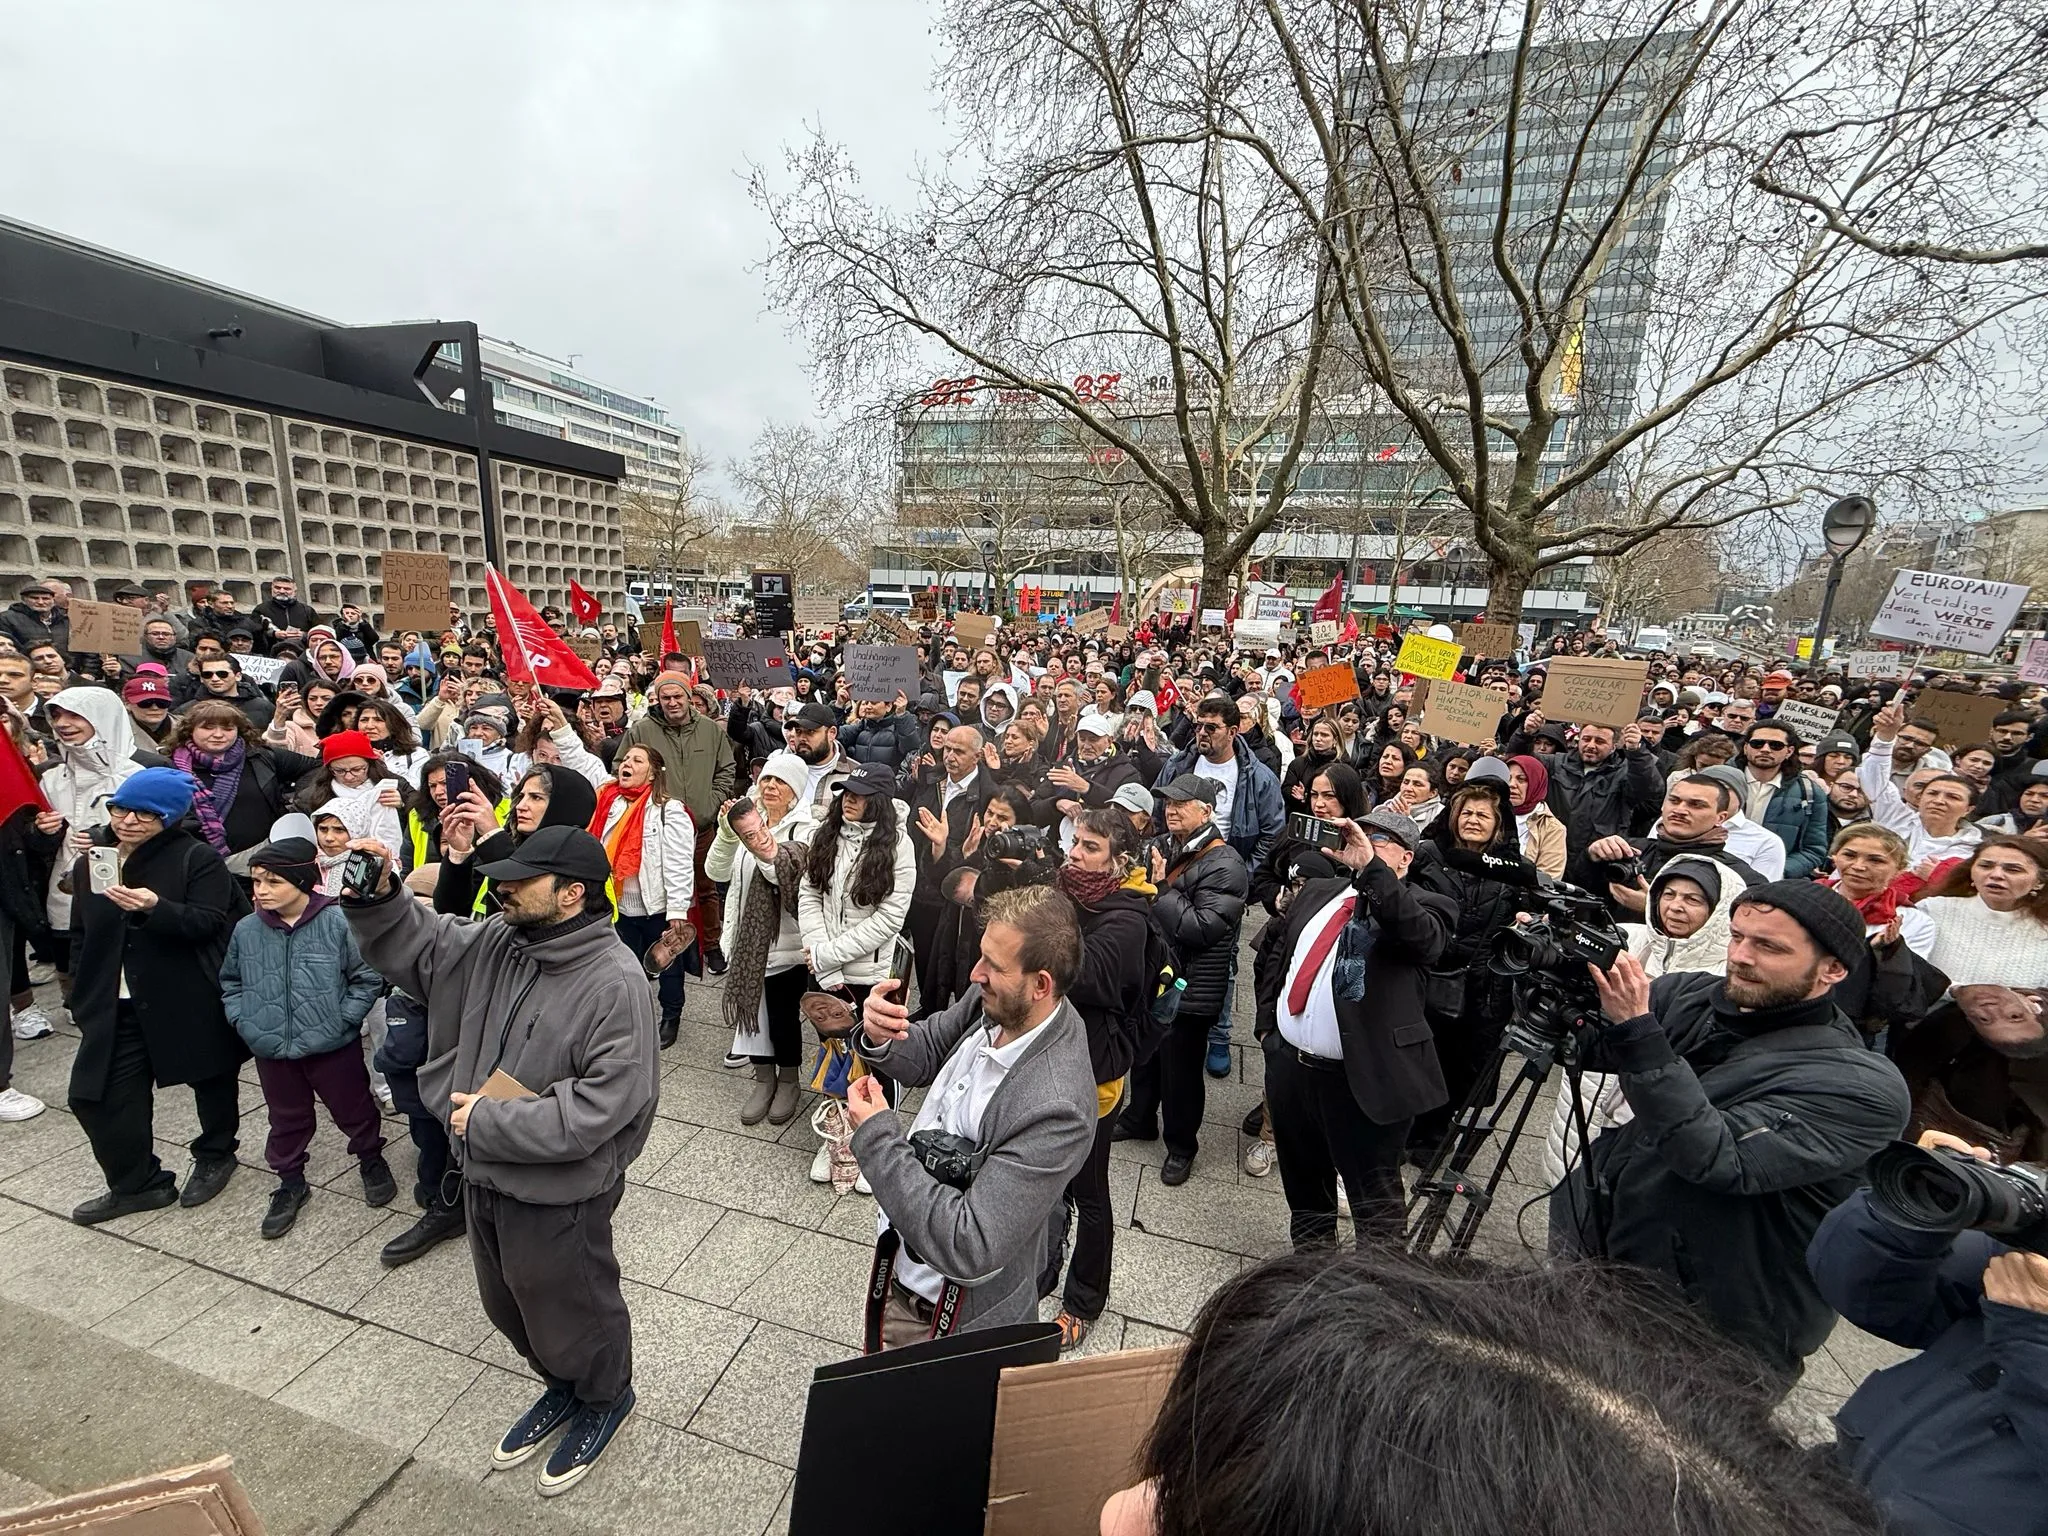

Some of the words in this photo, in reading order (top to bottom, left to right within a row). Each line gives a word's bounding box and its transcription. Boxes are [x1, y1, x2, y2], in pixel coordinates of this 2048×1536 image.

[385, 554, 449, 570] ERDOGAN
[384, 568, 411, 580] HAT
[415, 570, 449, 581] EINEN
[386, 581, 450, 602] PUTSCH
[1910, 573, 2009, 599] EUROPA!!!
[386, 602, 449, 614] GEMACHT
[1893, 586, 1993, 617] Verteidige
[1879, 611, 1893, 620] in
[1905, 617, 1931, 628] der
[1883, 599, 1921, 616] deine
[1934, 610, 1996, 631] WERTE
[1916, 630, 1964, 648] mit!!!
[1402, 650, 1453, 672] ADALET
[1855, 655, 1875, 664] we
[1876, 654, 1896, 663] are
[1857, 664, 1890, 674] CLEAN
[1436, 695, 1474, 709] HINTER
[1438, 682, 1455, 694] EU
[1484, 693, 1504, 704] AUF
[1563, 686, 1627, 702] SERBEST
[1563, 698, 1615, 717] BIRAK!
[1482, 853, 1503, 868] dpa
[1575, 933, 1591, 945] dpa
[873, 1258, 889, 1299] Canon
[944, 1284, 959, 1314] EOS
[939, 1312, 951, 1330] 6D
